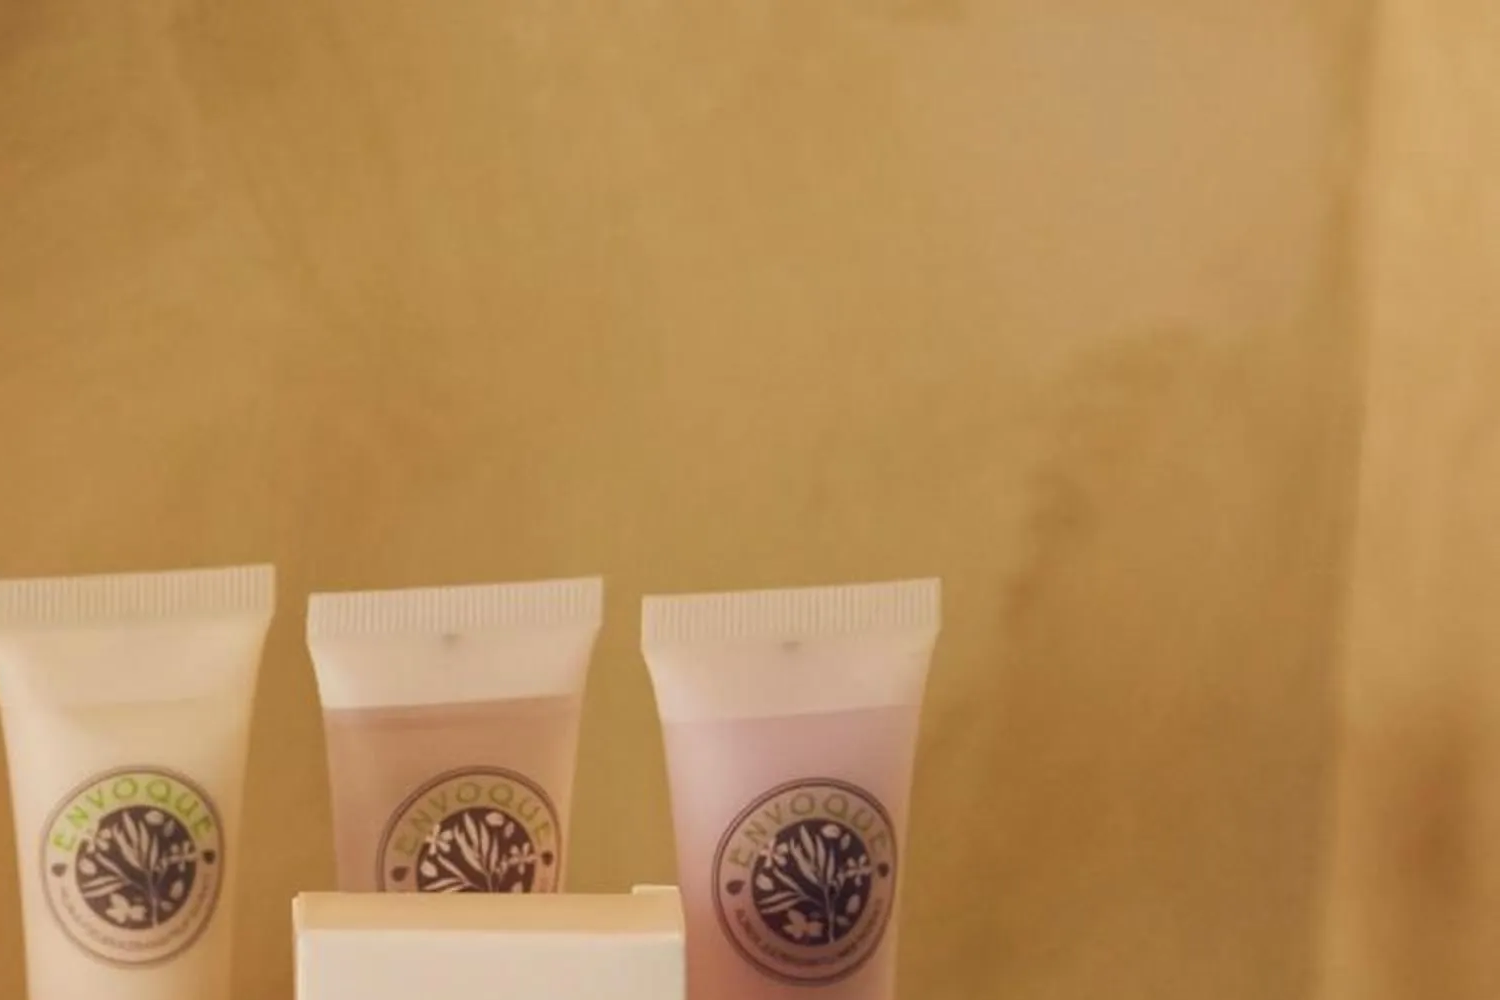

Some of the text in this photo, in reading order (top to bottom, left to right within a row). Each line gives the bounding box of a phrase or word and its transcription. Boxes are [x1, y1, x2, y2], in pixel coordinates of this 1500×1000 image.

[52, 777, 214, 850] ENVOQUE
[393, 781, 550, 857] ENVOQUE
[728, 792, 888, 869] ENVOQUE
